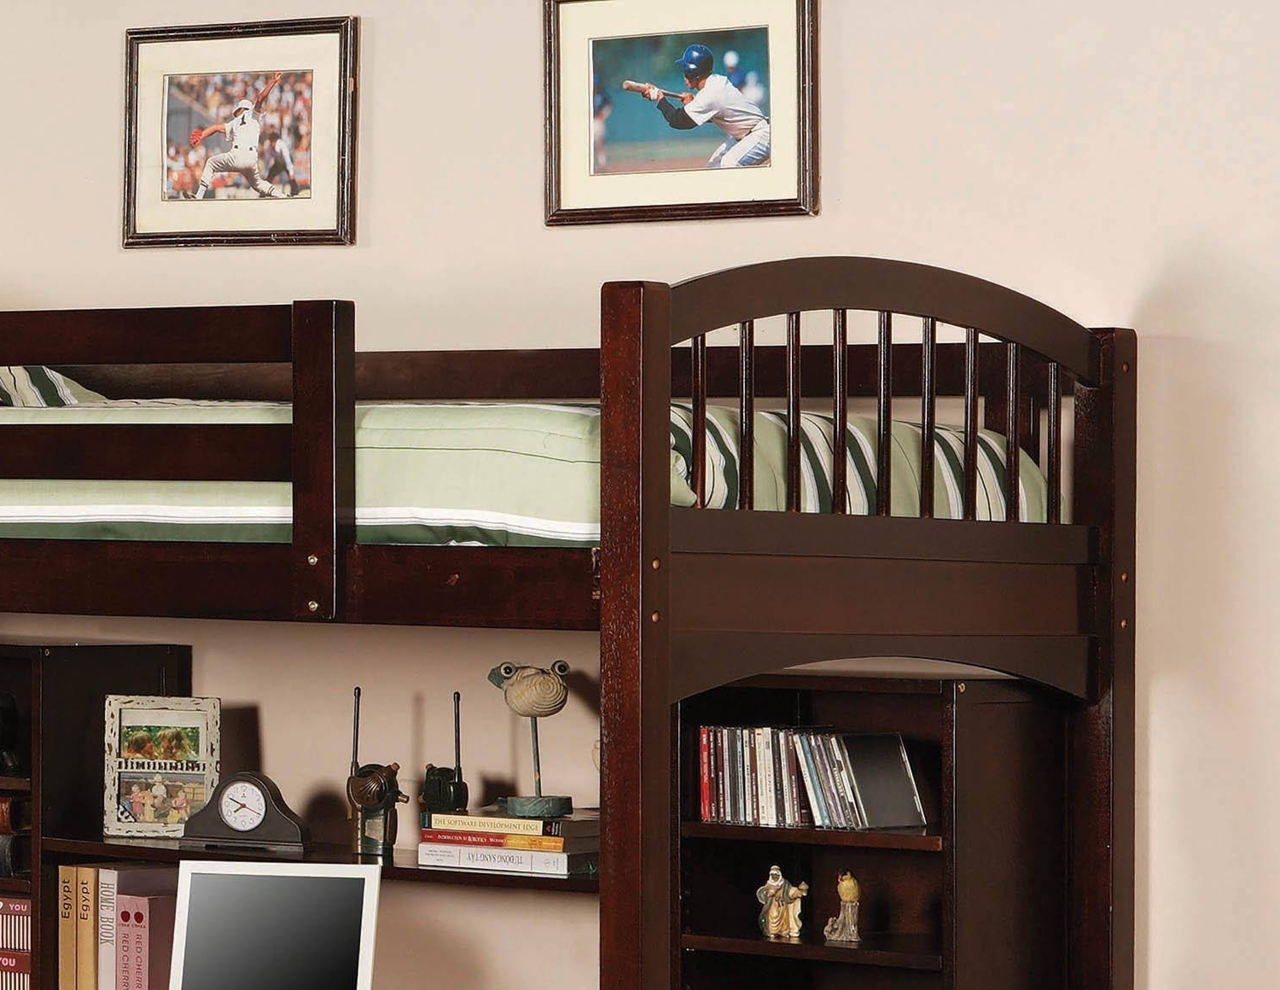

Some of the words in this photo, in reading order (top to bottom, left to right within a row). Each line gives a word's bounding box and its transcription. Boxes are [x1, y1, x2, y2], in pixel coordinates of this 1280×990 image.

[447, 819, 477, 827] SOFTWARE
[478, 821, 521, 831] DEVELOPMENT
[9, 902, 28, 913] YOU
[61, 878, 73, 919] Egypt
[79, 880, 91, 920] Egypt
[100, 882, 115, 912] HOME
[100, 916, 115, 946] BOOK
